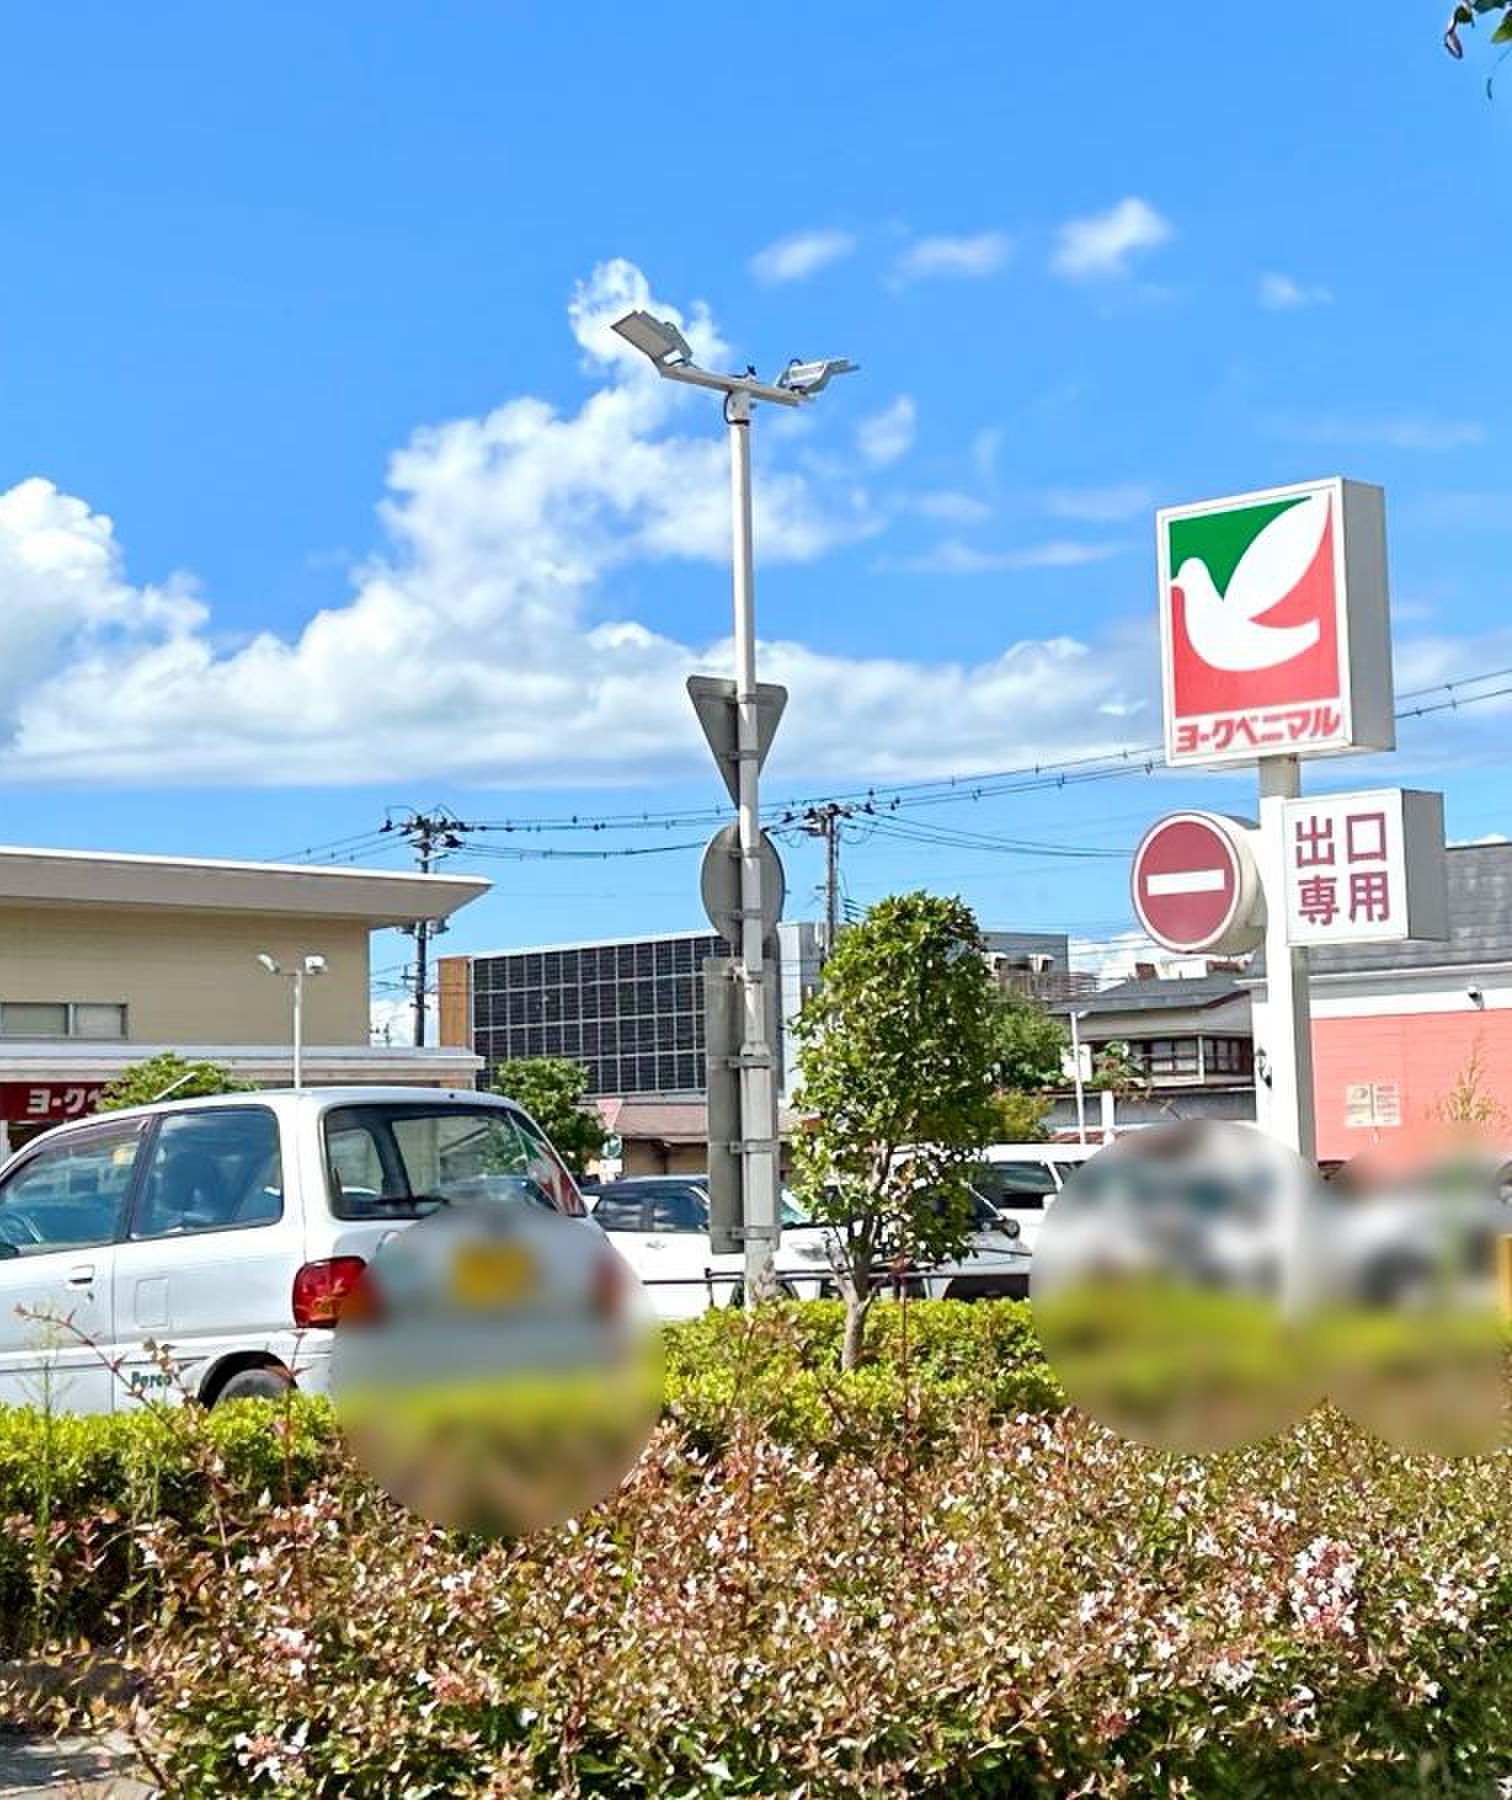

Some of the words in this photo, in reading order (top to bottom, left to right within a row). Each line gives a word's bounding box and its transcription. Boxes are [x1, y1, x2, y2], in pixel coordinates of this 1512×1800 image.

[1175, 706, 1343, 753] ヨークベニマル
[1295, 811, 1387, 869] 出口
[1298, 870, 1390, 926] 専用
